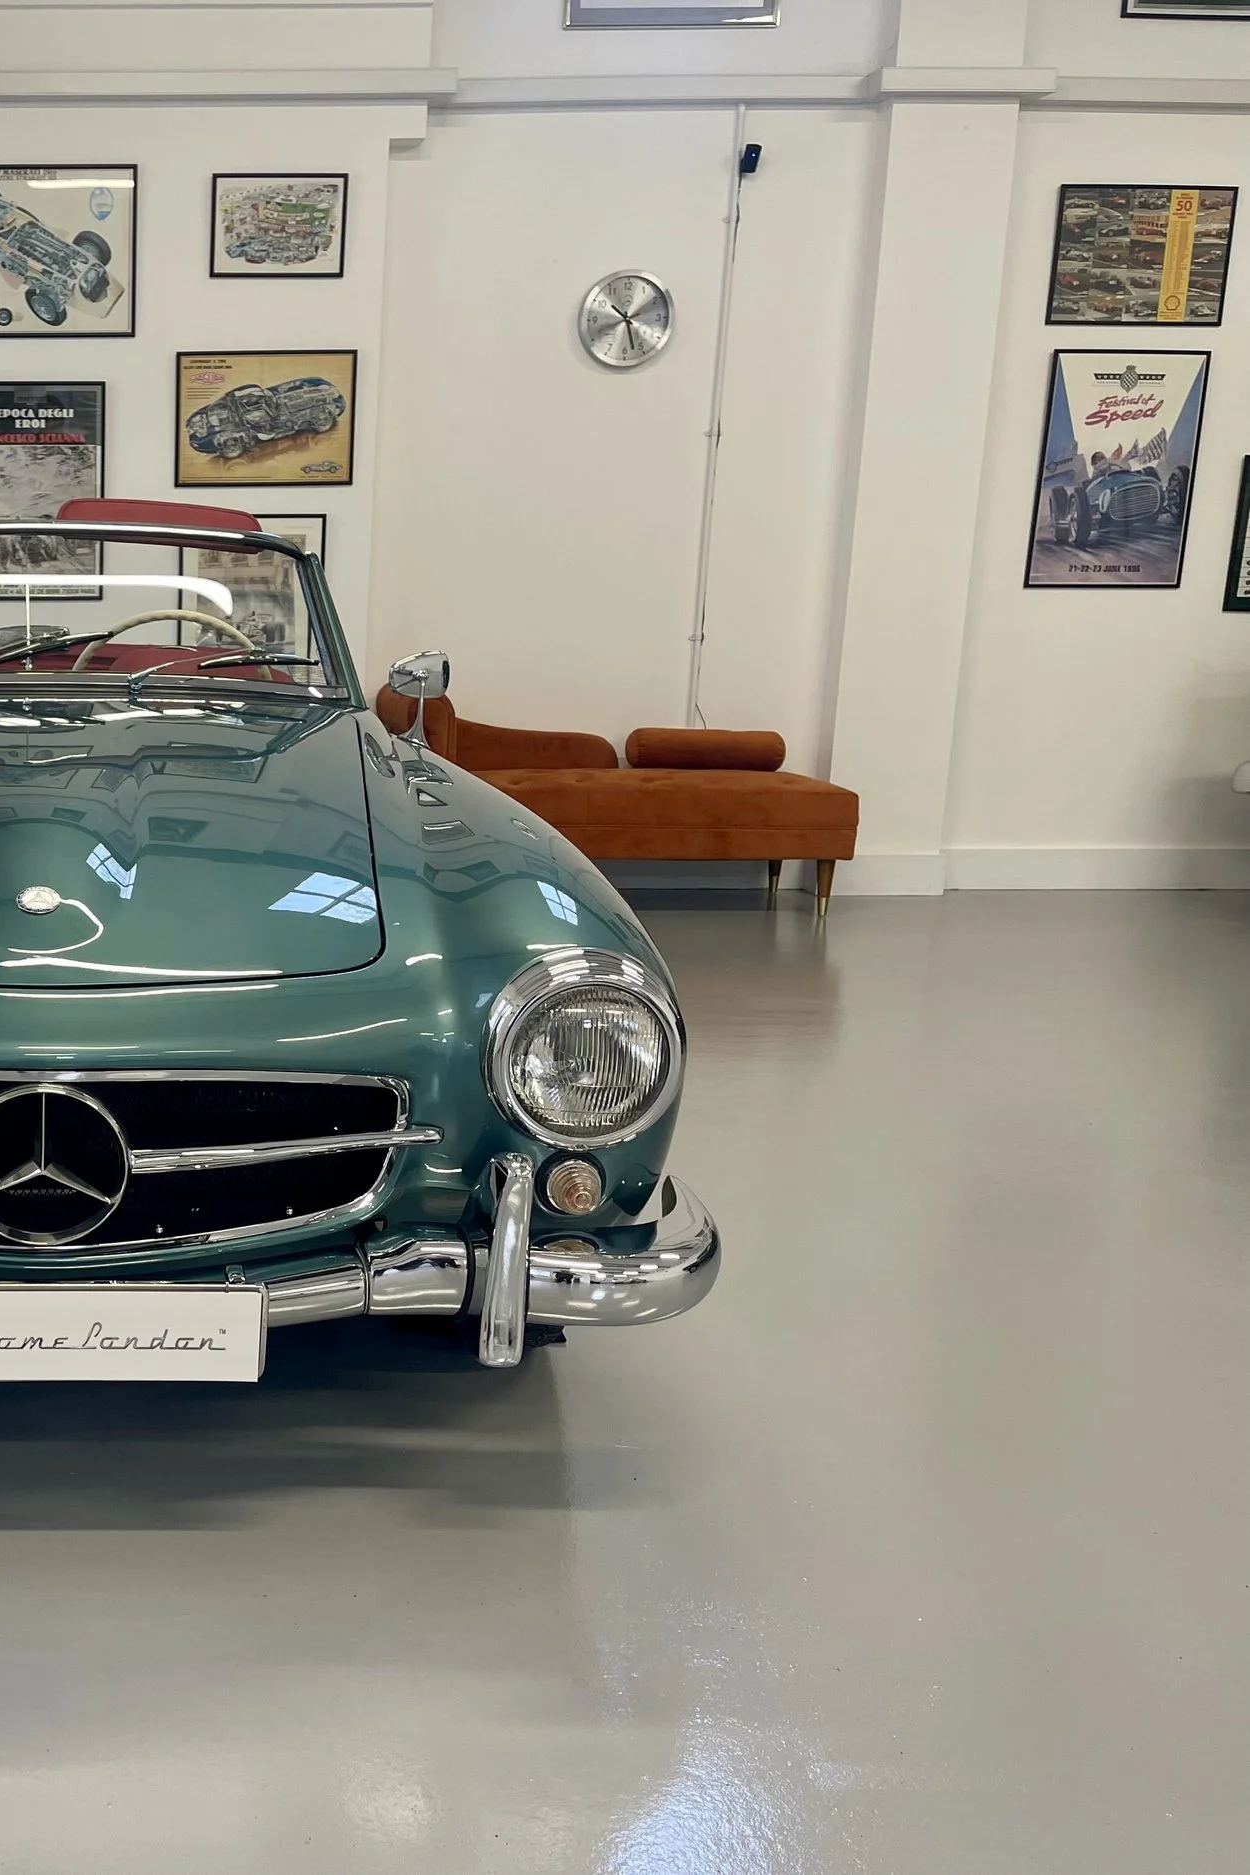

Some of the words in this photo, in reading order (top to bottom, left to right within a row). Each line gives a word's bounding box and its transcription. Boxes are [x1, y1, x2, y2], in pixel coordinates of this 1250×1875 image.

[1175, 200, 1193, 212] 50
[624, 282, 633, 291] 12
[608, 287, 617, 296] 11
[597, 300, 607, 308] 10
[592, 316, 598, 325] 9
[655, 313, 662, 322] 3
[607, 343, 613, 352] 7
[622, 346, 628, 355] 6
[638, 342, 644, 351] 5
[1097, 393, 1144, 410] Festival
[1141, 393, 1156, 406] of
[38, 408, 75, 418] DEGLI
[1084, 400, 1164, 429] Speed
[15, 419, 46, 429] EROI
